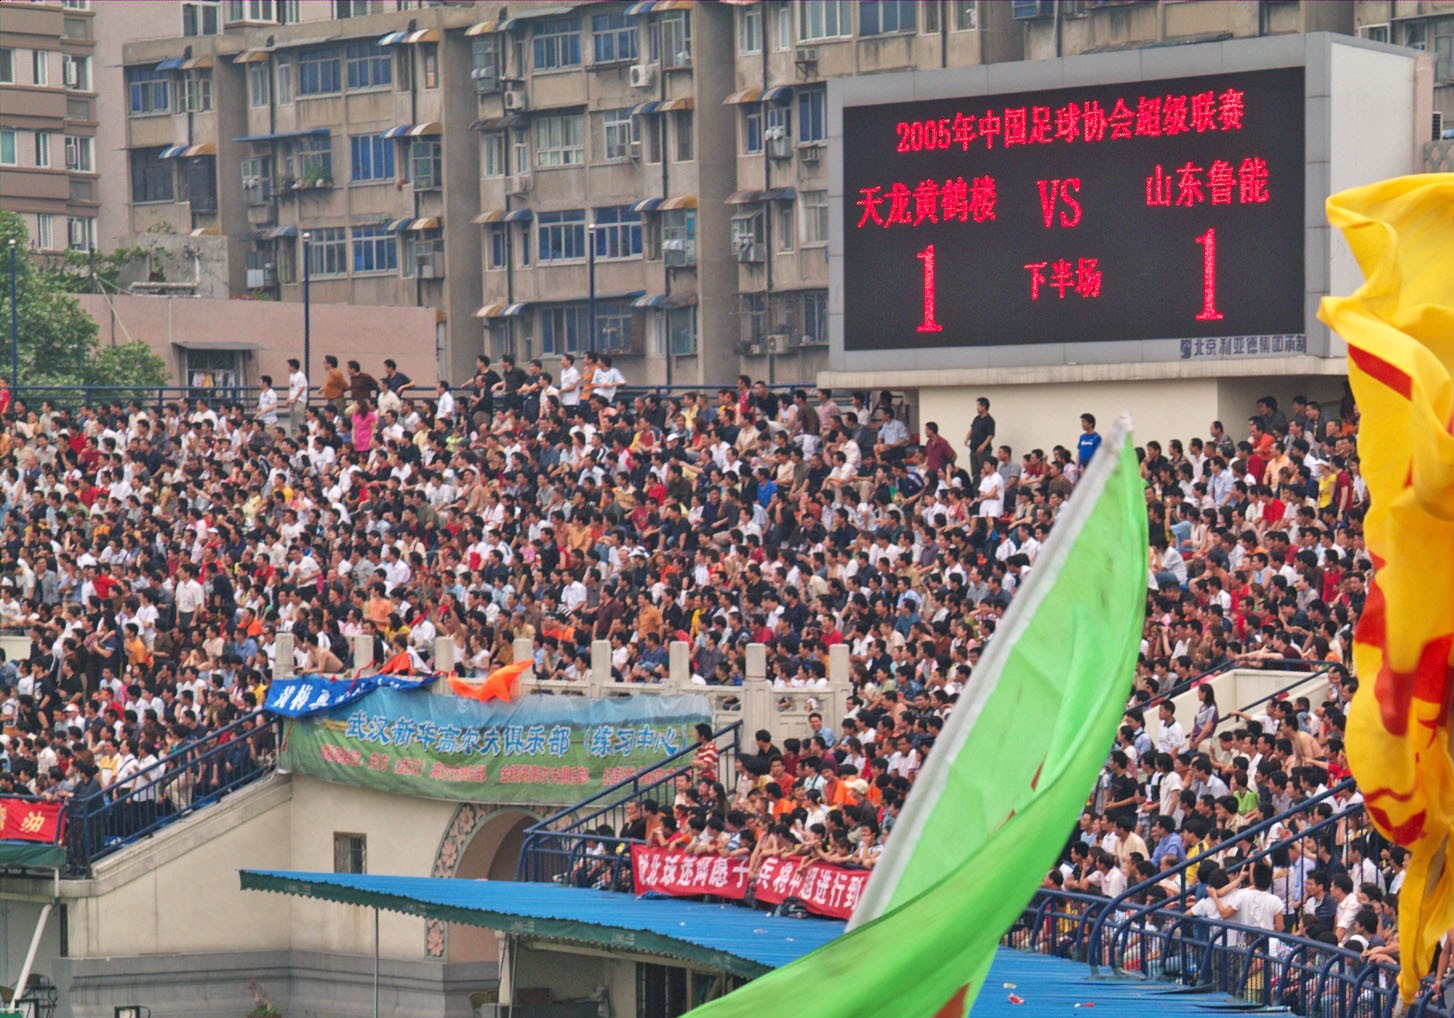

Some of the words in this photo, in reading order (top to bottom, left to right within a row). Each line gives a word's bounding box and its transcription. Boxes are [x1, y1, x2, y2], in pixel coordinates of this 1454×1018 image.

[896, 89, 1245, 153] 2005年中国足球协会超级联赛
[856, 174, 997, 229] 天龙黄鹤楼
[1037, 177, 1082, 229] VS
[1145, 156, 1271, 208] 山东鲁能
[915, 243, 944, 333] 1
[1024, 257, 1102, 300] 下半场
[1195, 227, 1224, 321] 1
